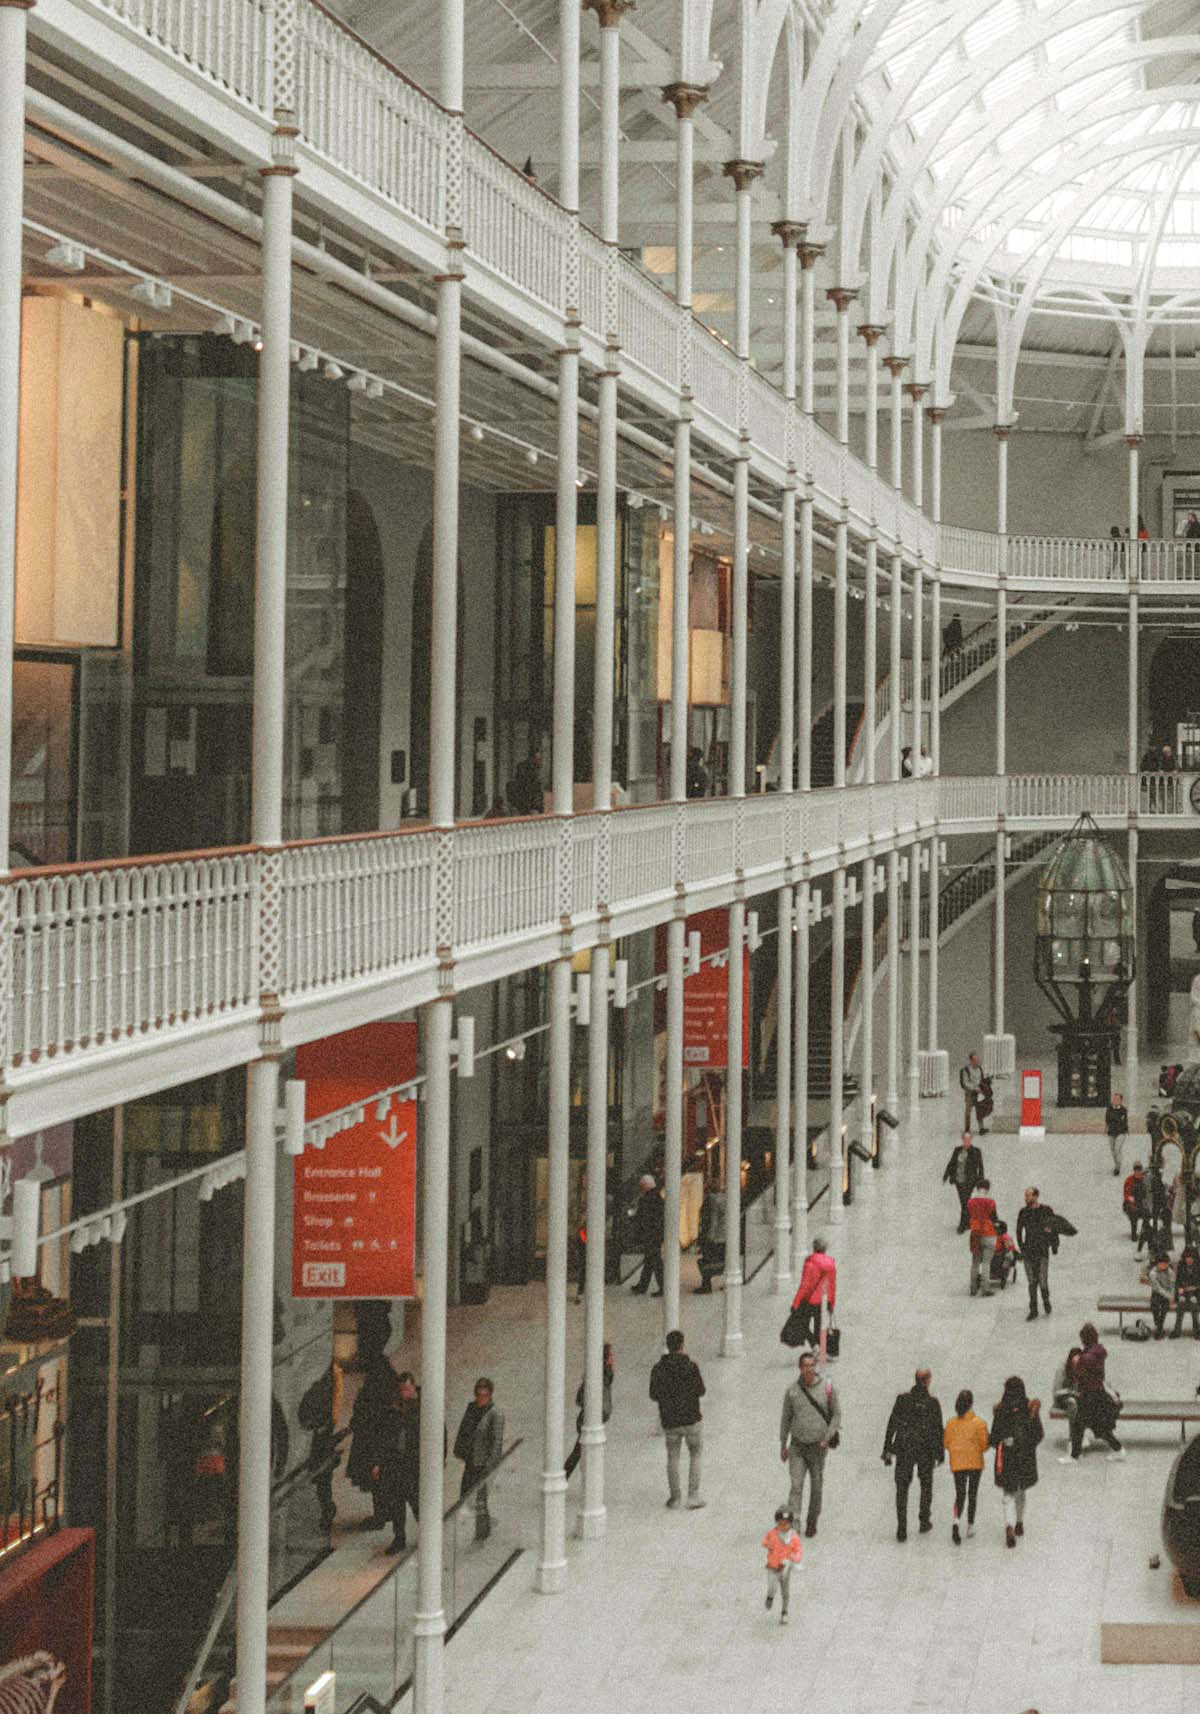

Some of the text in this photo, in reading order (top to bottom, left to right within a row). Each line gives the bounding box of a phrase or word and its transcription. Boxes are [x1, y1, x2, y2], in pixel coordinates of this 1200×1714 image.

[304, 1167, 382, 1178] Entrance Hall
[303, 1216, 333, 1228] Shop
[303, 1240, 341, 1251] Toilets
[307, 1267, 339, 1282] Exit
